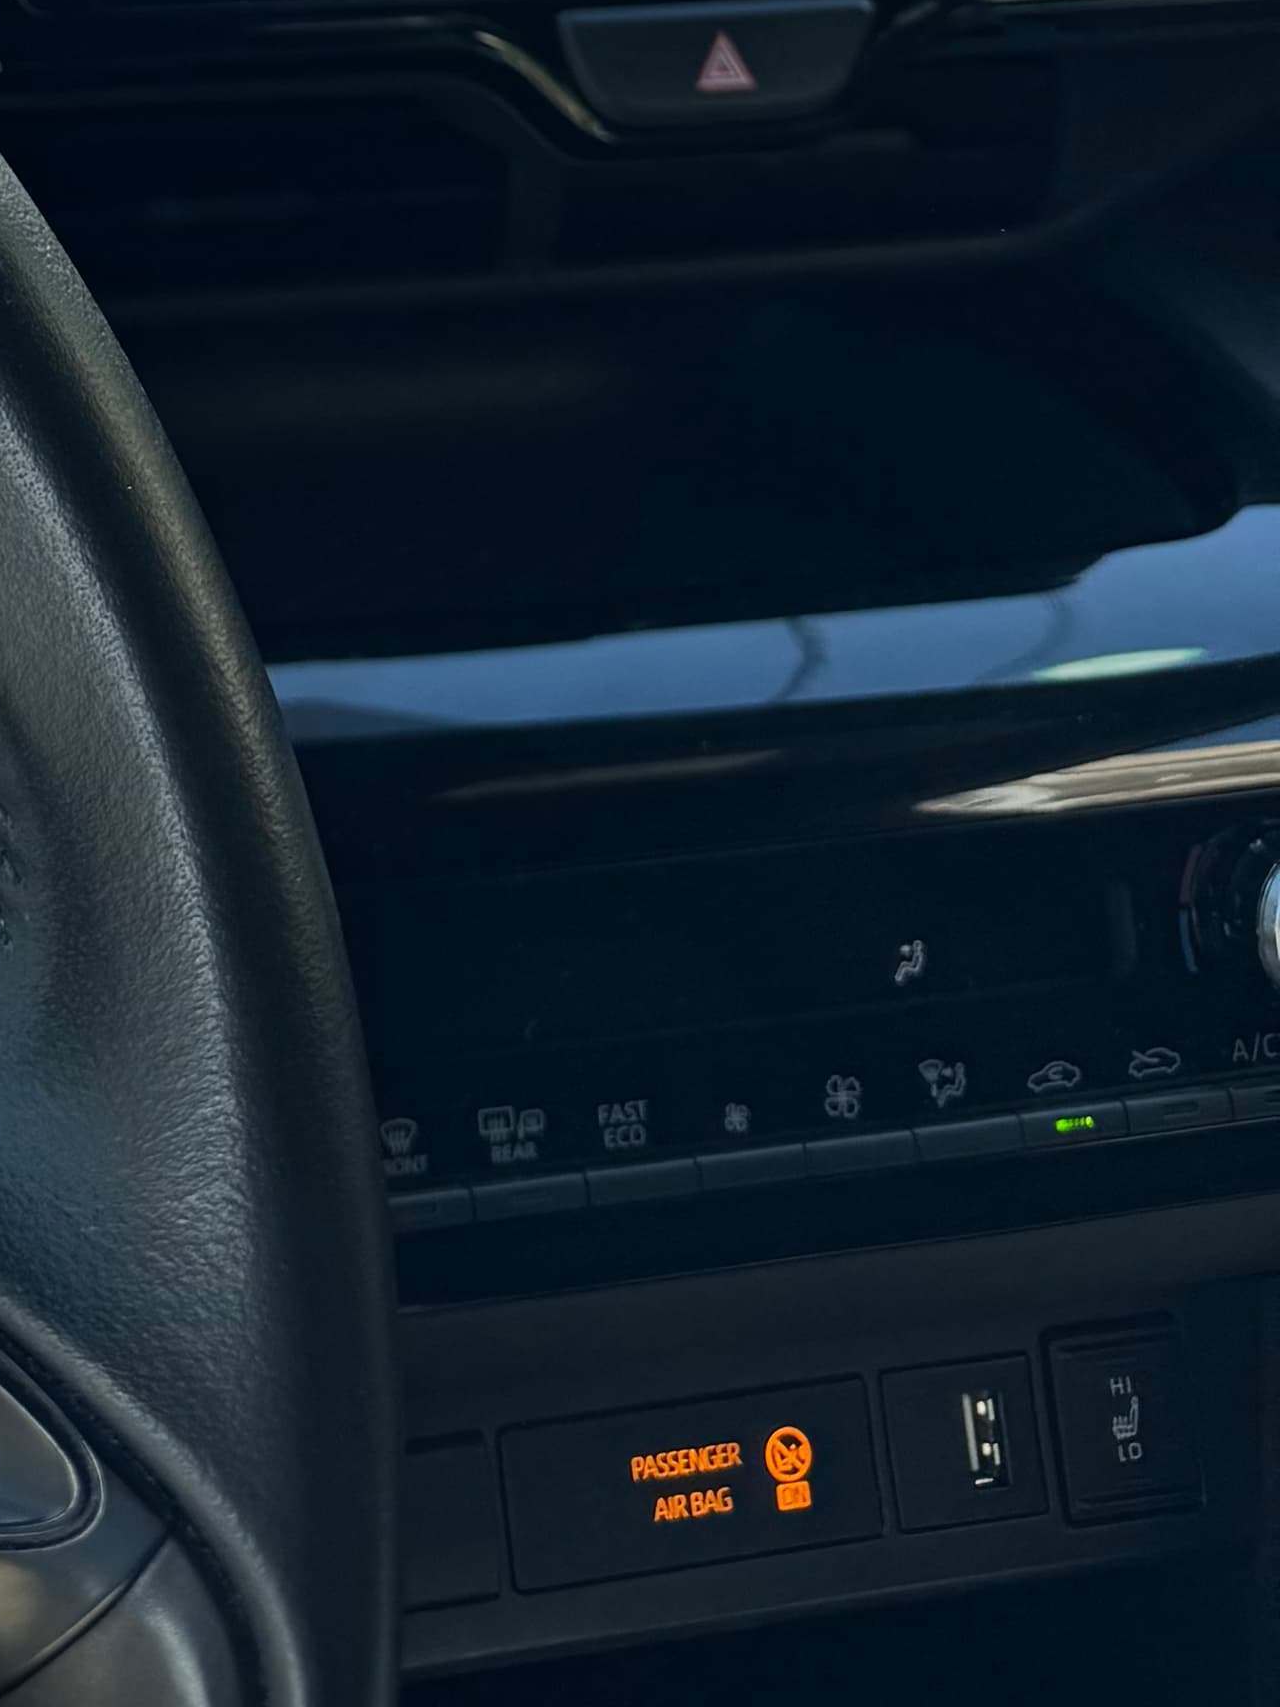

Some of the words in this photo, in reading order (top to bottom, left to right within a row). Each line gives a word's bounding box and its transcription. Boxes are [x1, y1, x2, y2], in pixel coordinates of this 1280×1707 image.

[1232, 1031, 1280, 1062] A/C
[597, 1099, 649, 1125] FAST
[603, 1124, 646, 1149] ECO
[491, 1141, 538, 1164] REAR
[1109, 1375, 1132, 1396] HI
[629, 1441, 743, 1482] PASSENGER
[1118, 1442, 1143, 1462] LO
[653, 1493, 689, 1523] AIR
[690, 1486, 734, 1518] BAG
